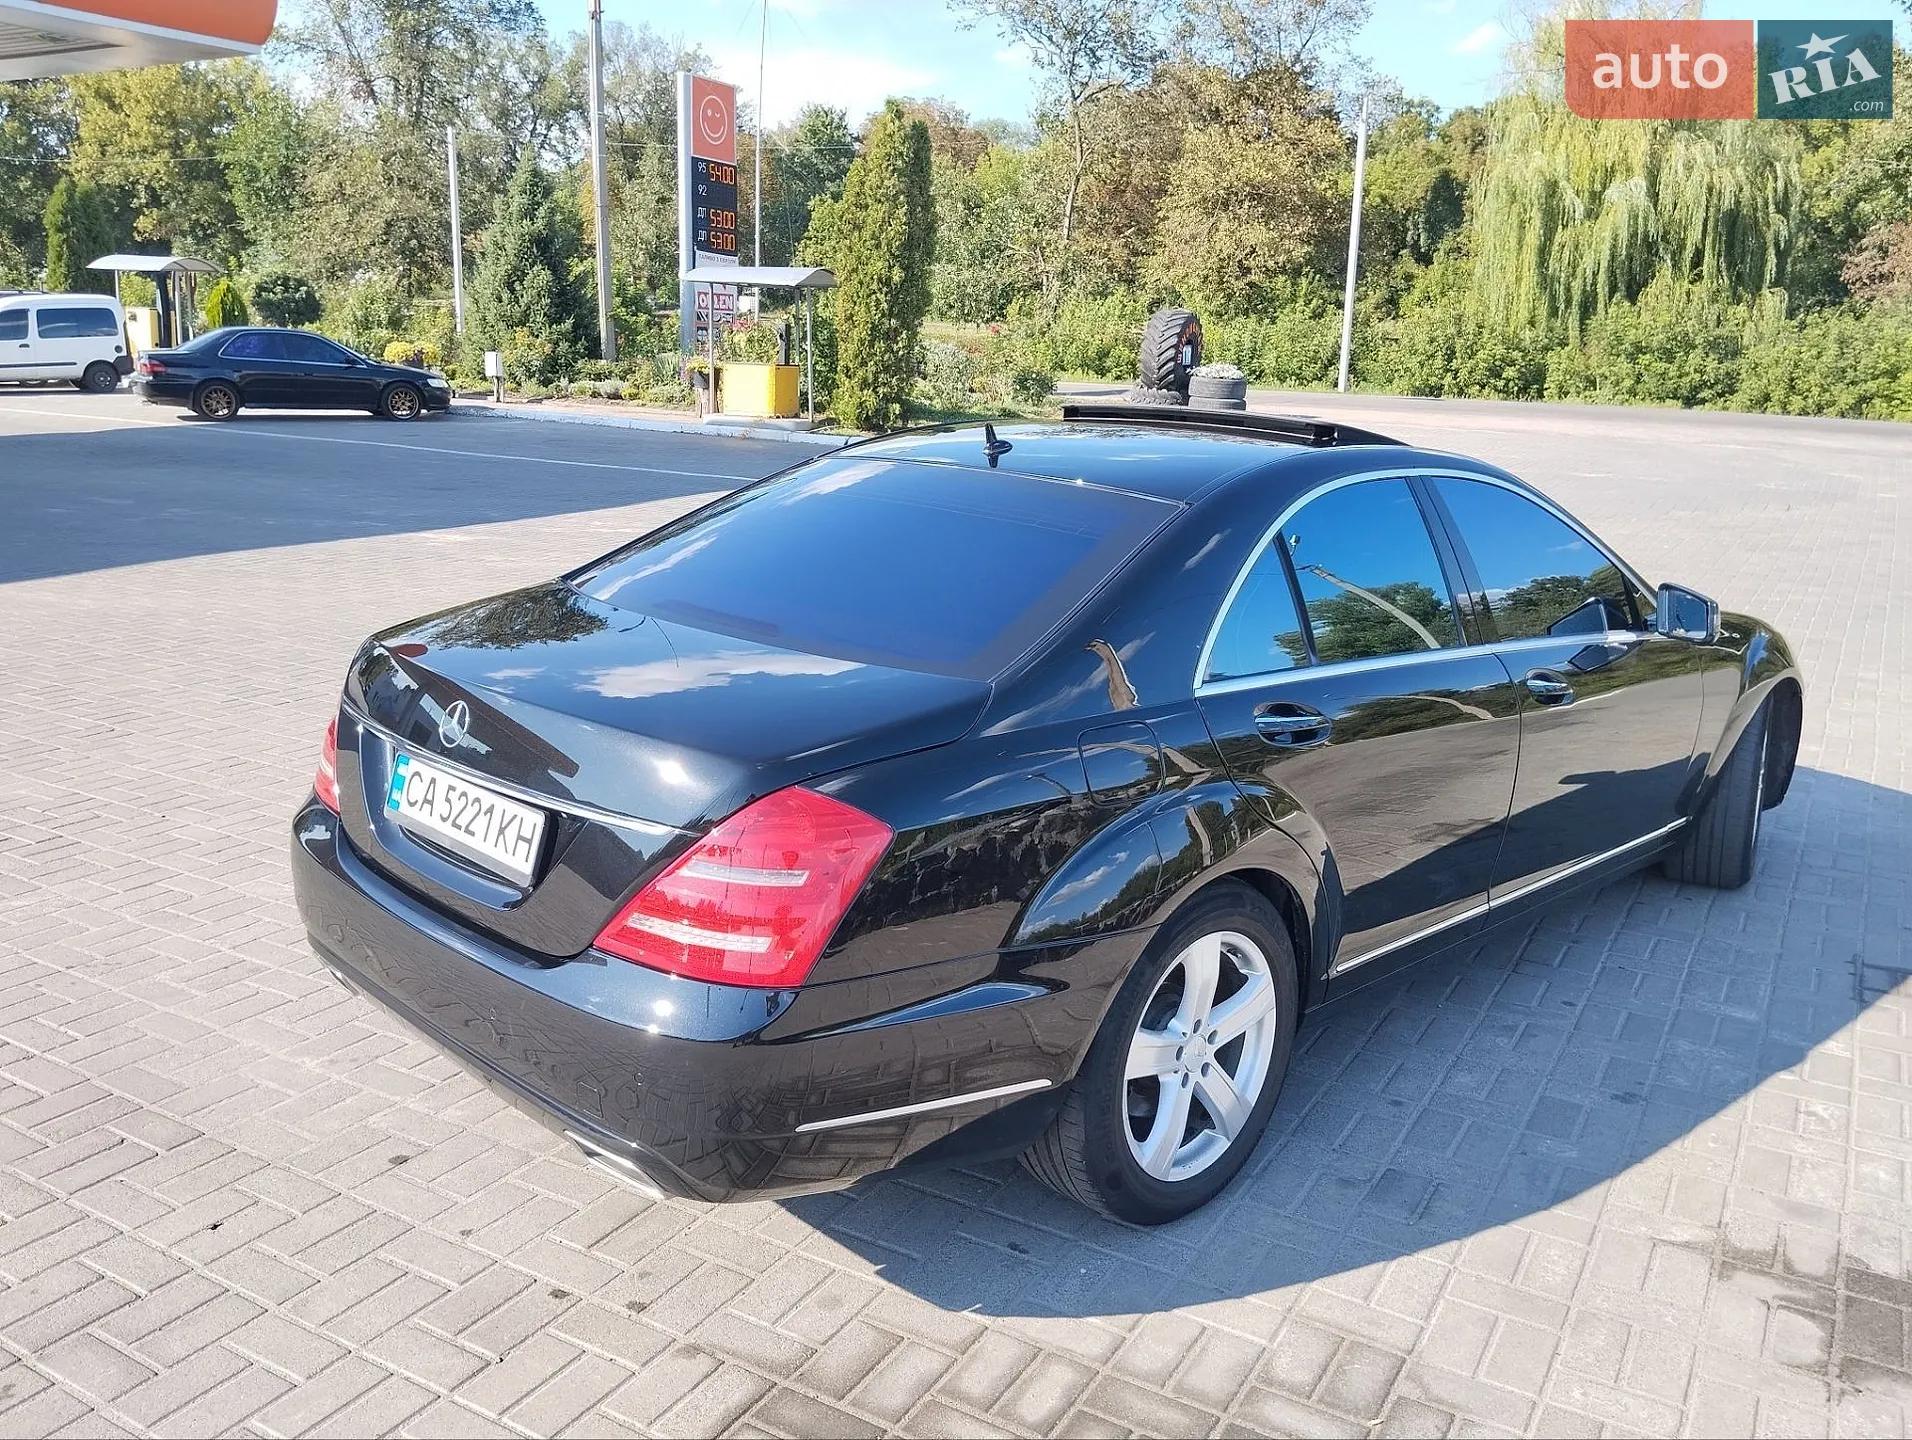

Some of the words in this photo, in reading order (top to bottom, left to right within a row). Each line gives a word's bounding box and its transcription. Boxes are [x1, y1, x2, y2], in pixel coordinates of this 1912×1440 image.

[698, 161, 707, 173] 95
[697, 184, 707, 196] 92
[406, 771, 437, 817] CA
[439, 784, 496, 843] 5221
[494, 808, 537, 863] KH
